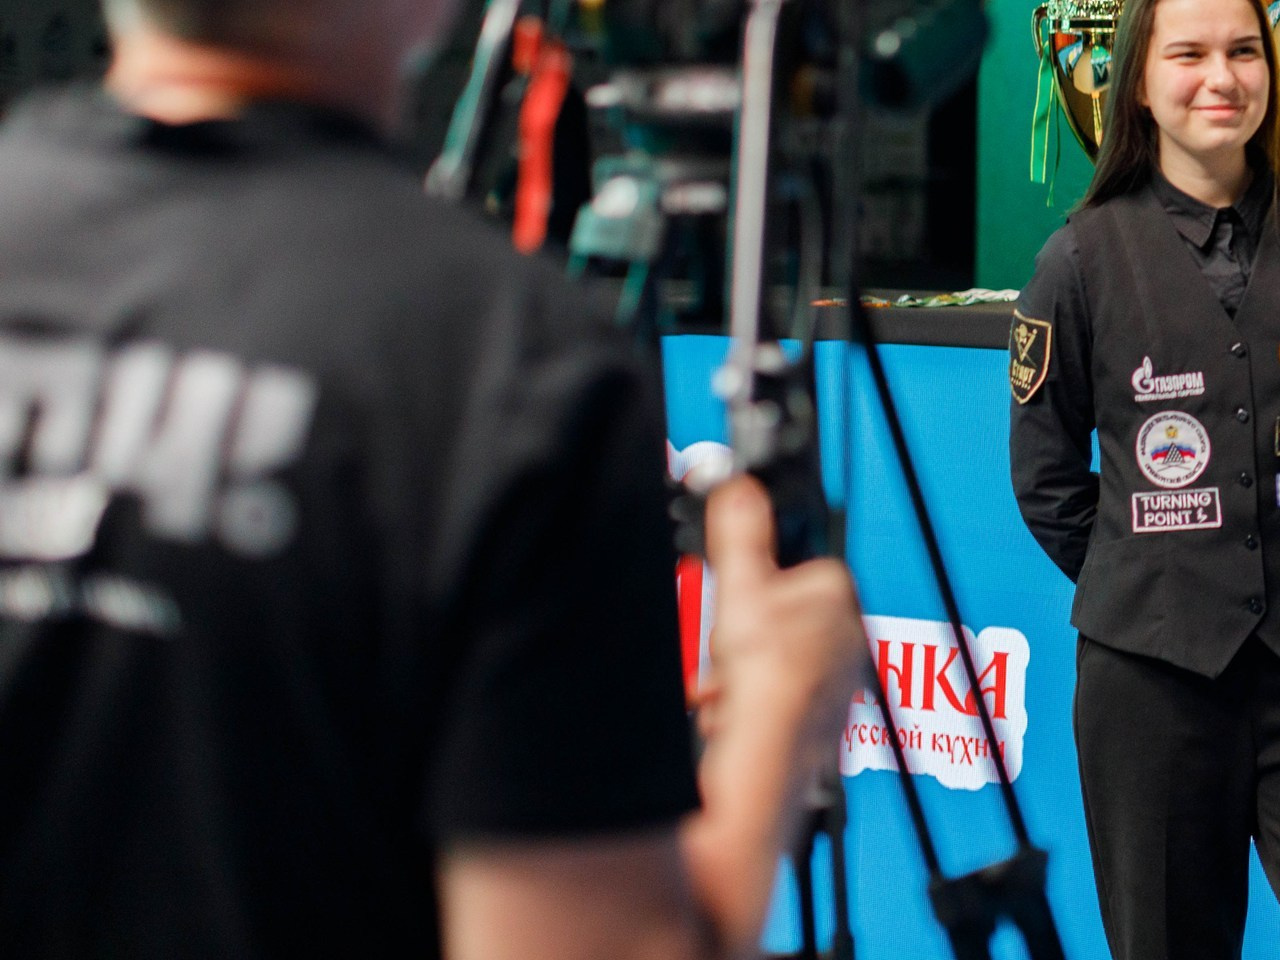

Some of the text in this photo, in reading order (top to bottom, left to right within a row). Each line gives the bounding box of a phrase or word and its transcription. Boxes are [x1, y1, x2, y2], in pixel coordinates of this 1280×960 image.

[1154, 371, 1205, 394] ГАЗПРОМ
[1141, 493, 1211, 512] TURNING
[1144, 510, 1193, 527] POINT
